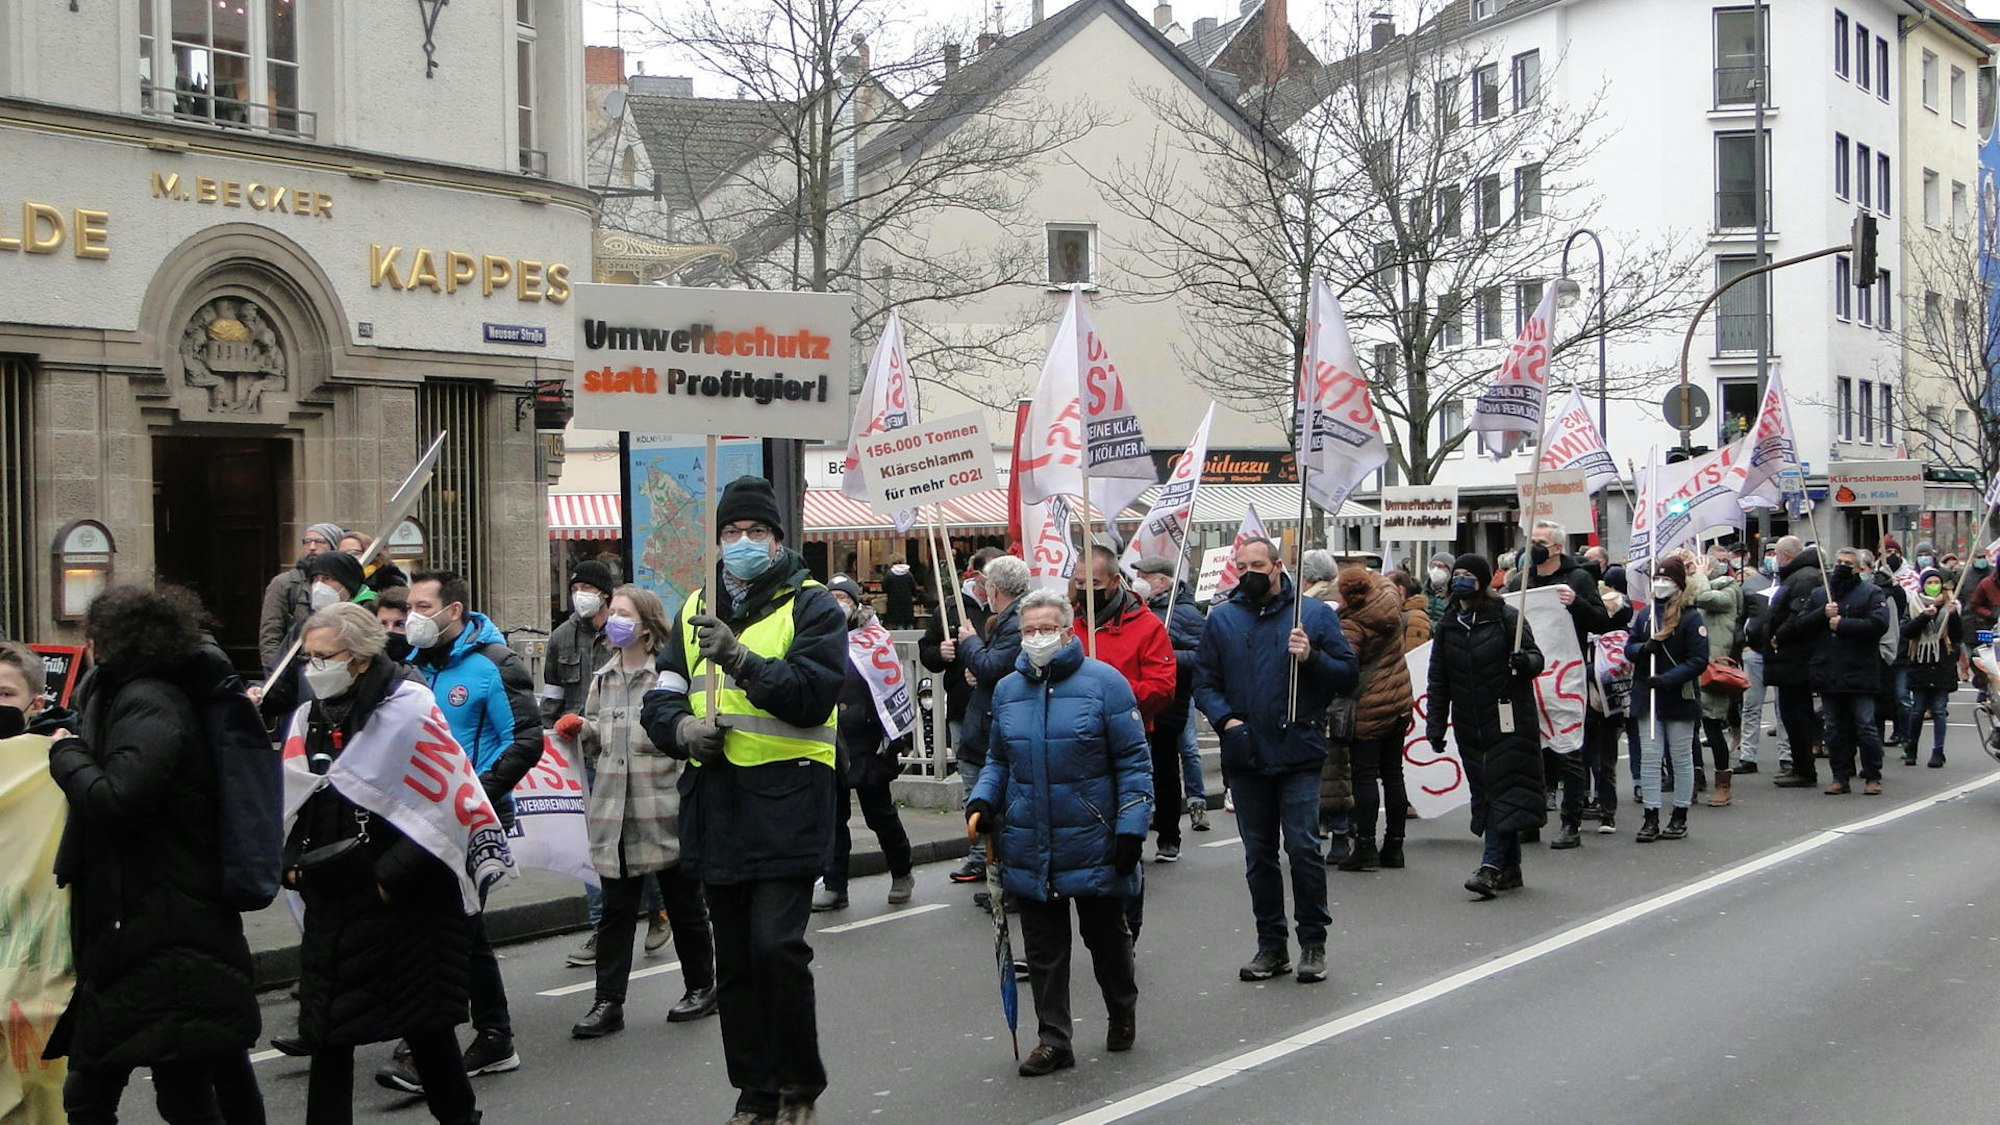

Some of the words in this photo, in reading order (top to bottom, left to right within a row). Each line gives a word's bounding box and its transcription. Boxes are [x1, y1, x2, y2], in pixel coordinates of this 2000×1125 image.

[0, 200, 109, 259] DE
[369, 242, 571, 303] KAPPES
[489, 326, 519, 340] Neusser
[521, 328, 543, 343] Straße
[584, 319, 831, 361] Umweltschutz
[583, 366, 659, 395] statt
[667, 368, 828, 405] Profitgier!
[866, 435, 922, 458] 156.000
[925, 424, 979, 445] Tonnen
[880, 449, 974, 479] Klärschlamm
[885, 486, 905, 501] für
[910, 479, 945, 496] mehr
[949, 468, 983, 487] CO2!
[516, 798, 585, 814] -VERBRENNUNG
